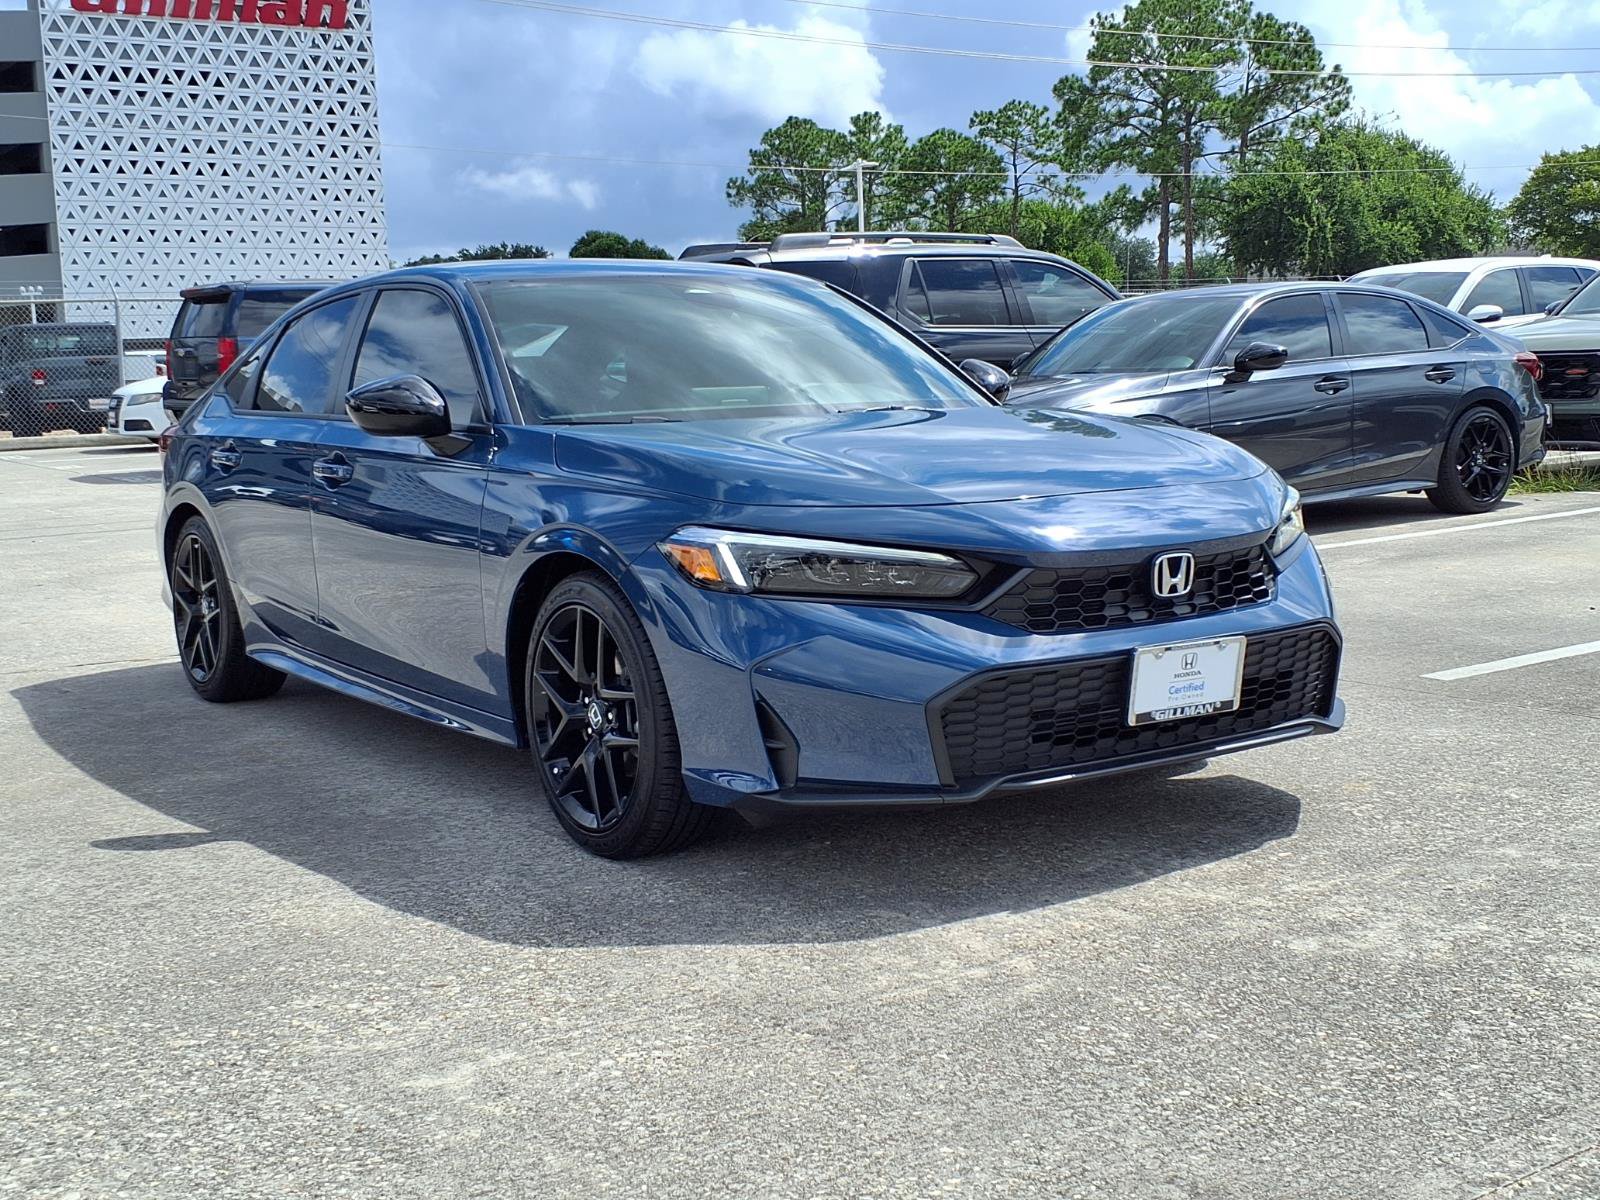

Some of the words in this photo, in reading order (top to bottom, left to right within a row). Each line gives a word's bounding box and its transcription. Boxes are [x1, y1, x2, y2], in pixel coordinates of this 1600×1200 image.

[1174, 670, 1202, 679] HONDA
[1168, 681, 1205, 695] Certified
[1154, 703, 1214, 721] GILLMAN
